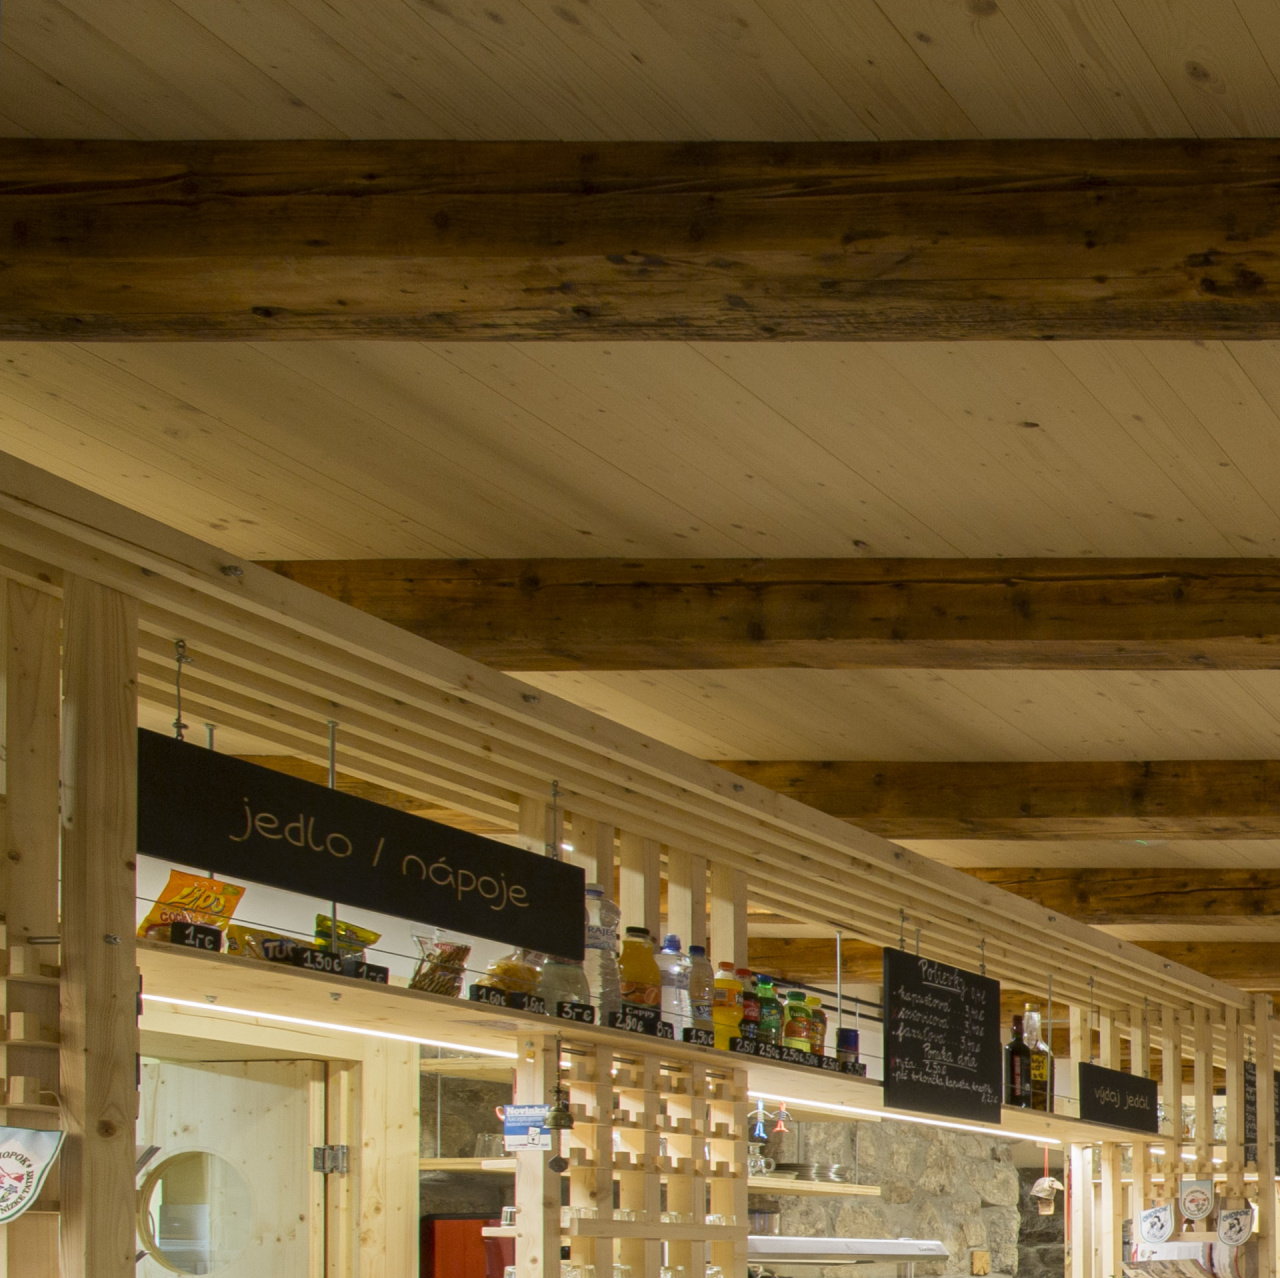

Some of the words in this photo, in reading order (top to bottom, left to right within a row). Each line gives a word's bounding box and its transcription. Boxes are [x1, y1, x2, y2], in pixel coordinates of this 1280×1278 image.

[228, 797, 353, 858] jedlo
[372, 837, 385, 867] /
[401, 856, 530, 911] nápoje
[587, 926, 616, 937] RAJEC
[625, 1007, 656, 1018] Cappy
[1094, 1085, 1120, 1108] výdaj
[506, 1106, 549, 1115] Novinka!
[0, 1194, 26, 1215] NÍZKE
[22, 1170, 34, 1196] TATRY
